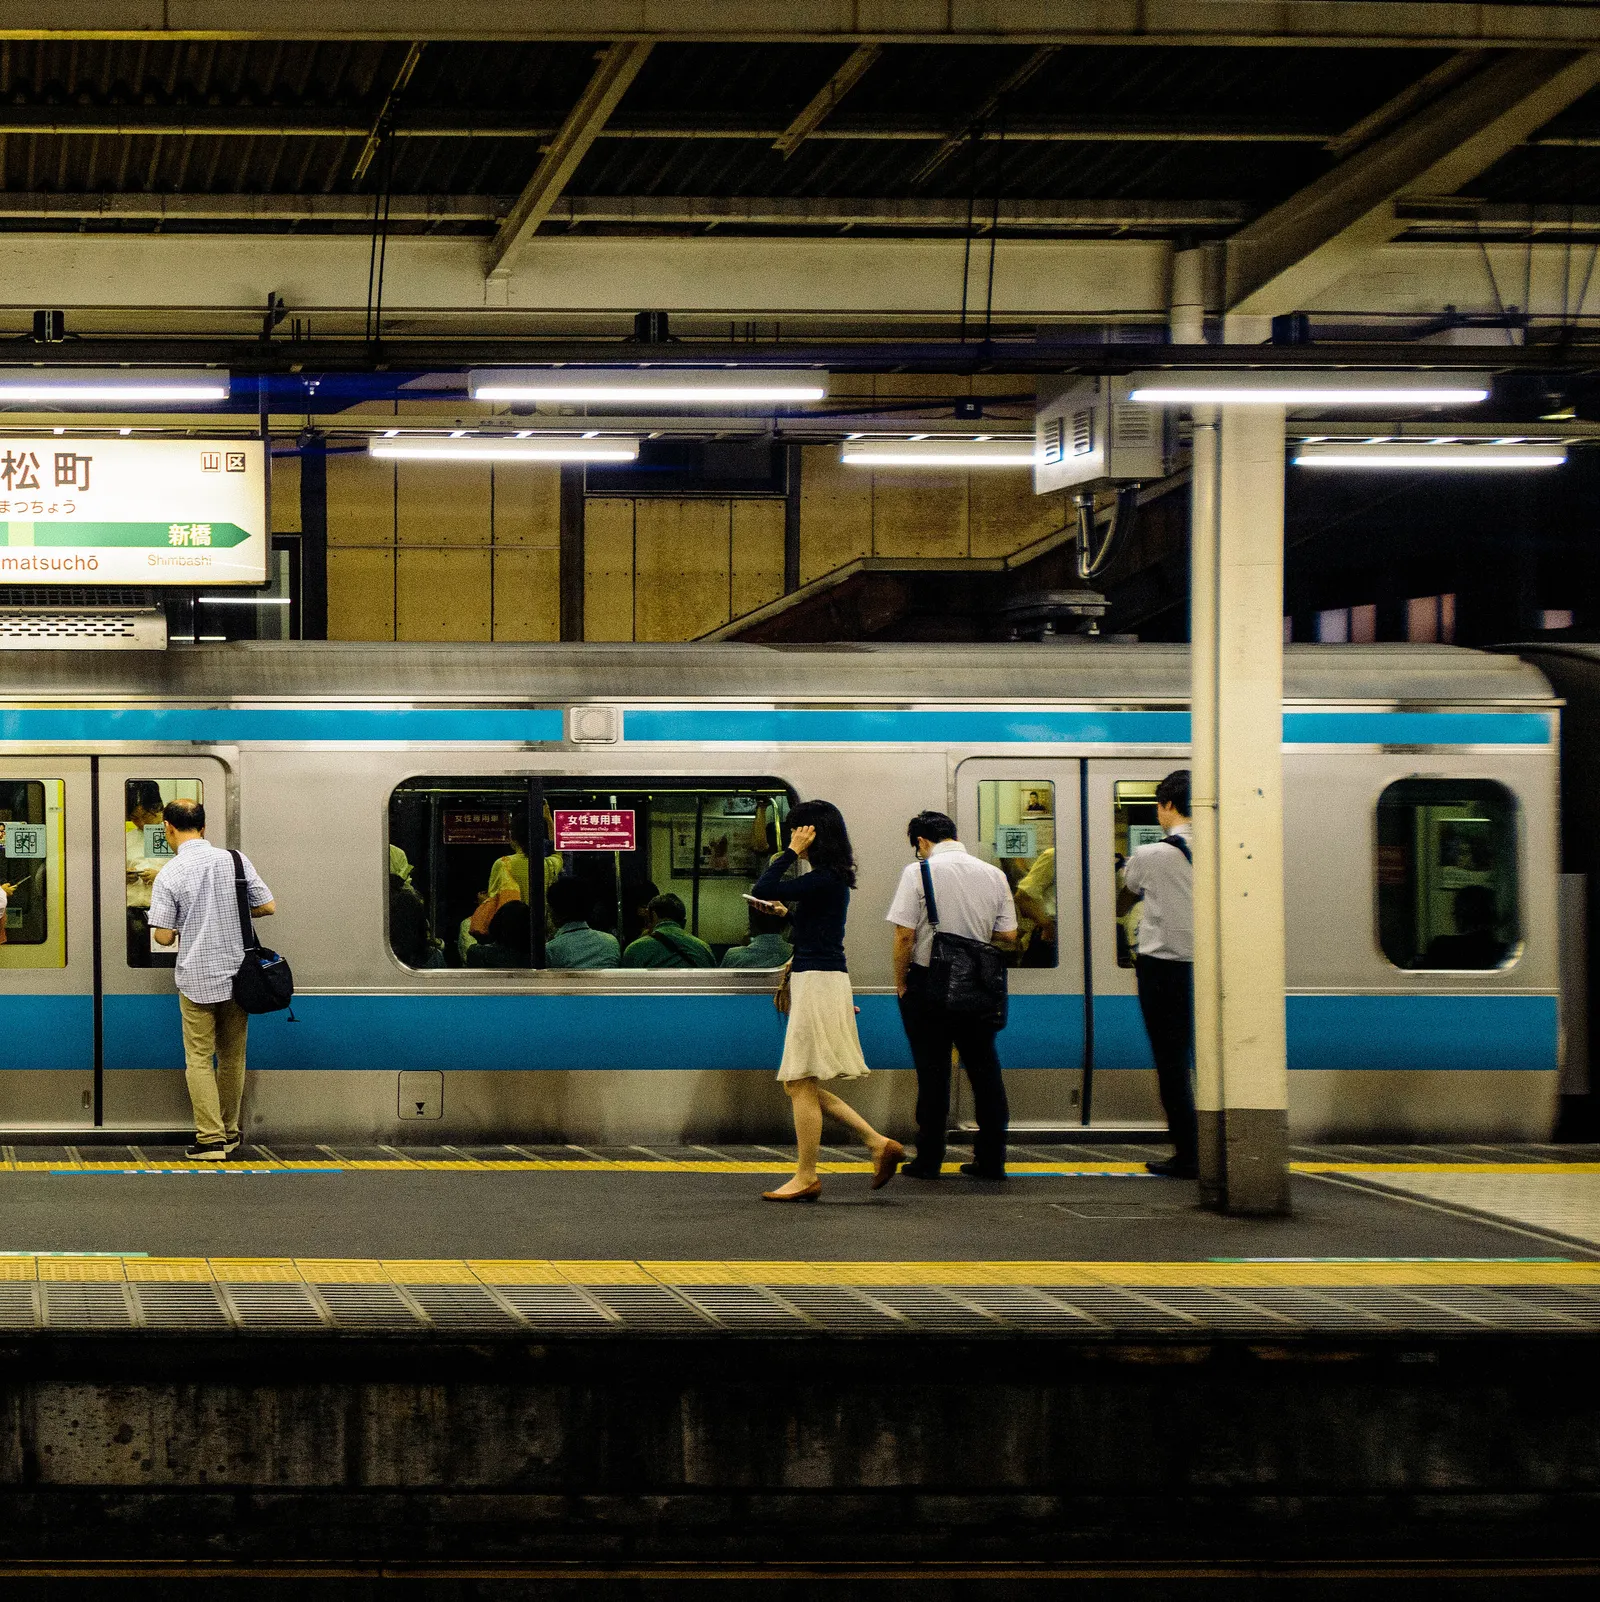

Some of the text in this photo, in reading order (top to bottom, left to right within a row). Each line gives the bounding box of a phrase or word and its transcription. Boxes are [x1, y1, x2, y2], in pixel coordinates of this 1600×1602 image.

[202, 453, 245, 472] 山 区
[168, 524, 212, 547] 新橋
[147, 554, 212, 567] Shimbashi
[568, 815, 622, 825] 女性専用車
